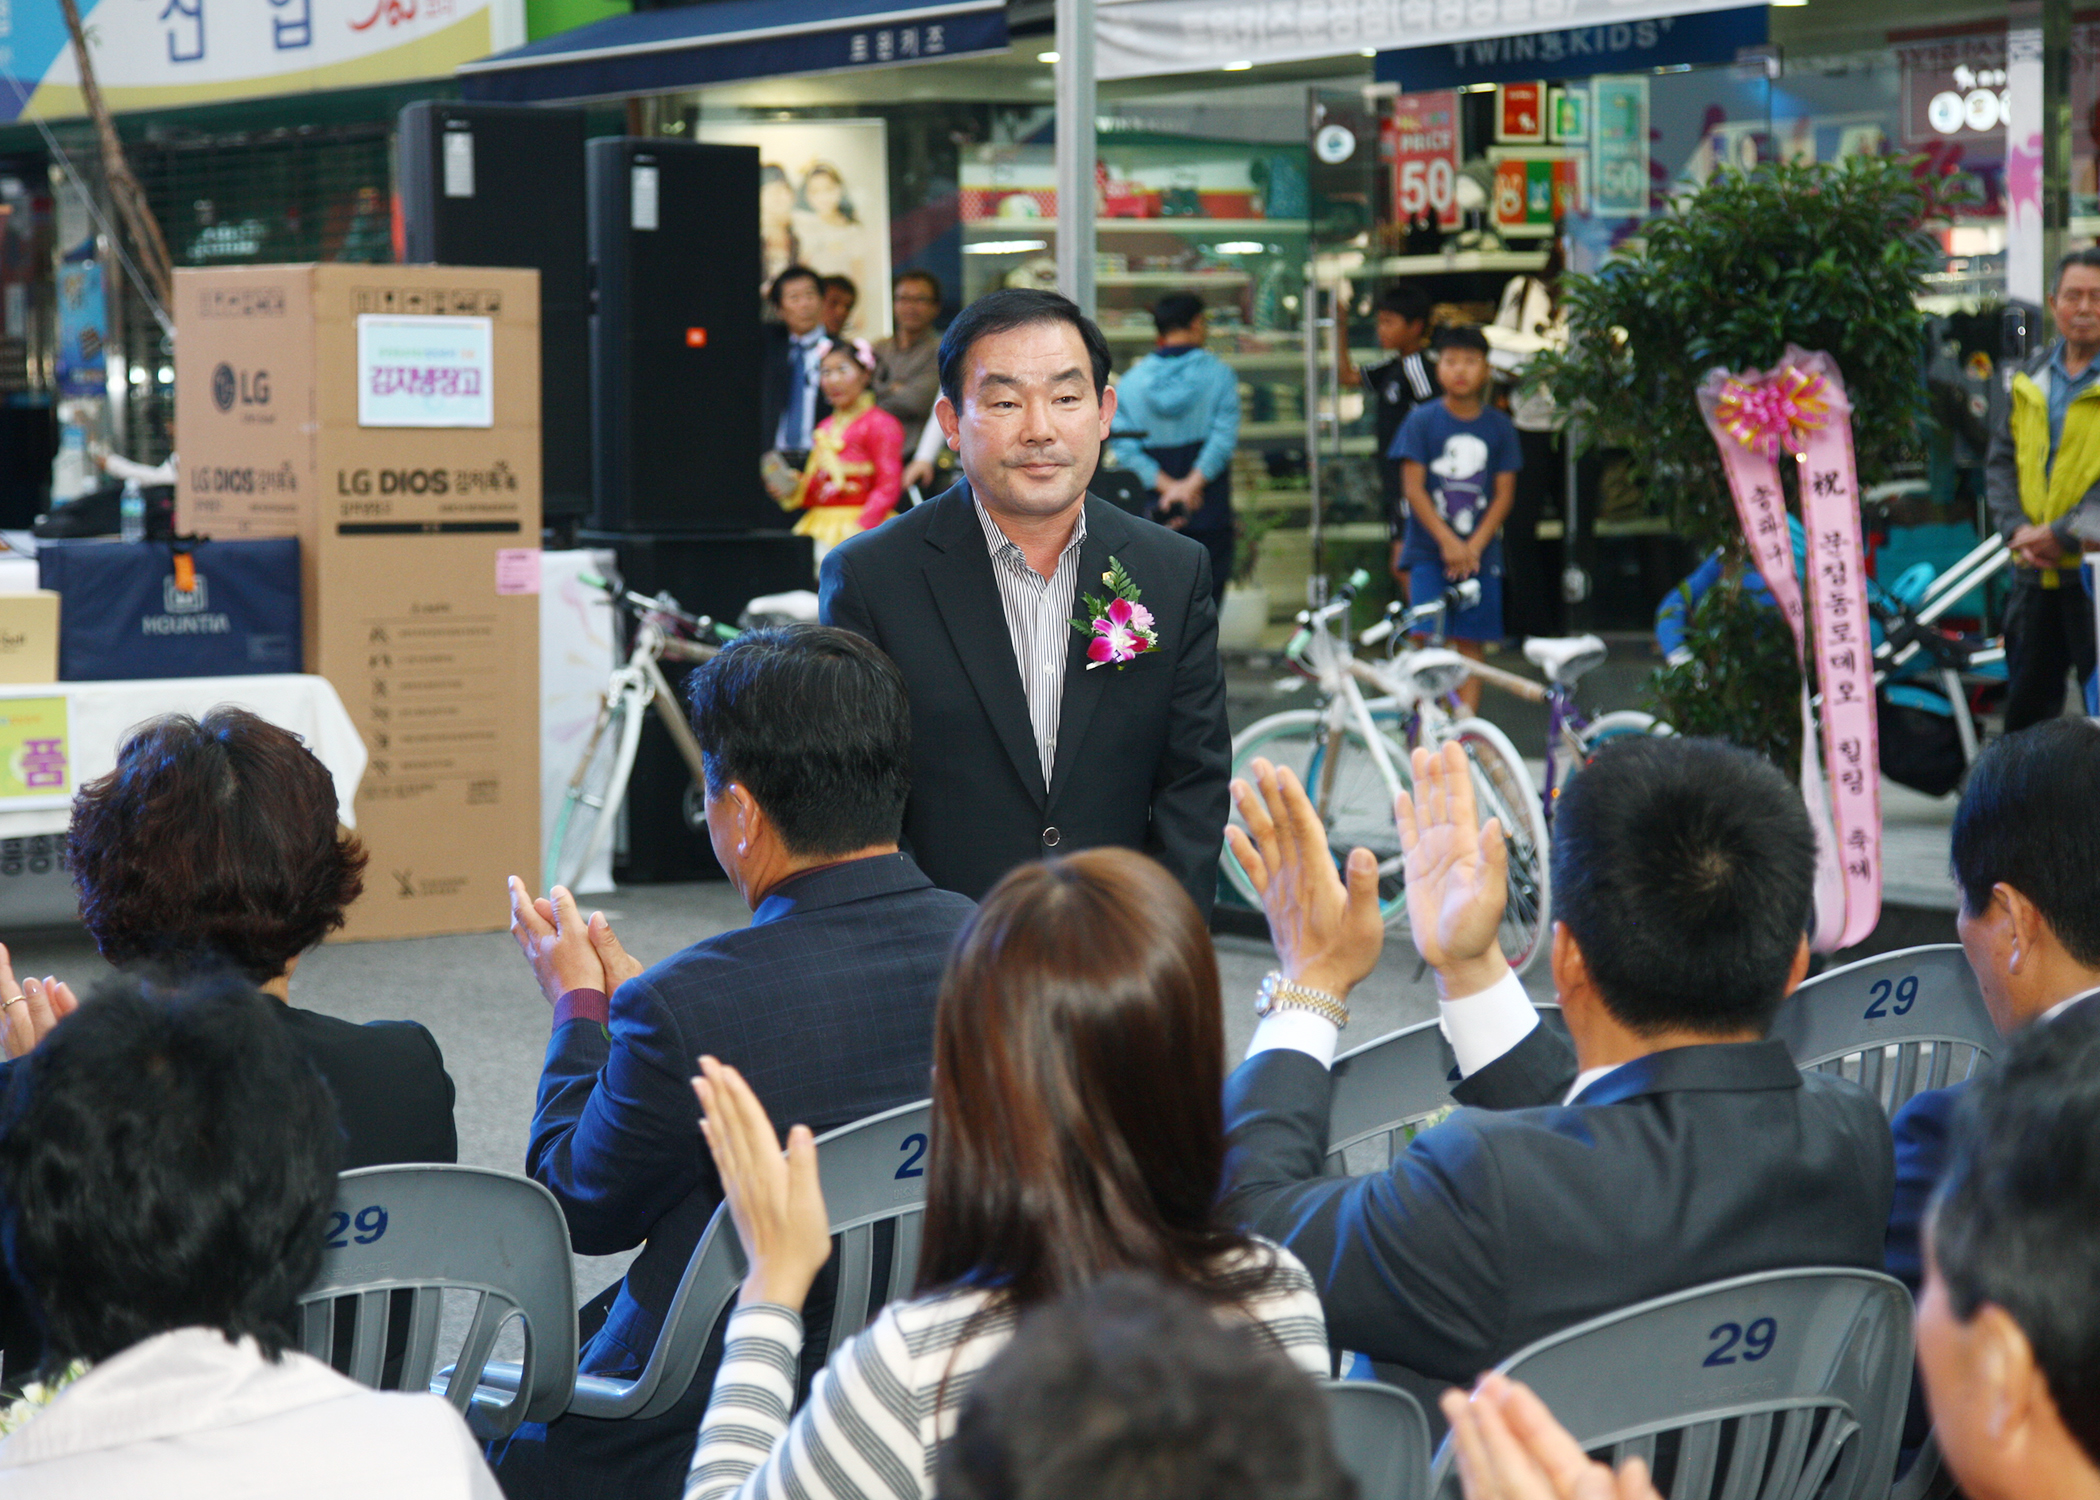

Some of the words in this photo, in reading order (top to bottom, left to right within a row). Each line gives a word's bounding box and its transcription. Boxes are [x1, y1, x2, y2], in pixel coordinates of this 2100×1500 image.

[849, 24, 947, 62] 트윈키즈
[1400, 158, 1455, 214] 50
[240, 369, 271, 405] LG
[337, 467, 372, 496] LG
[379, 467, 450, 496] DIOS
[1812, 470, 1846, 498] 祝
[141, 613, 231, 636] MOUNTIA
[21, 738, 68, 787] 품
[1863, 975, 1919, 1020] 29
[894, 1132, 929, 1180] 2
[324, 1204, 389, 1251] 29
[1702, 1316, 1778, 1369] 29
